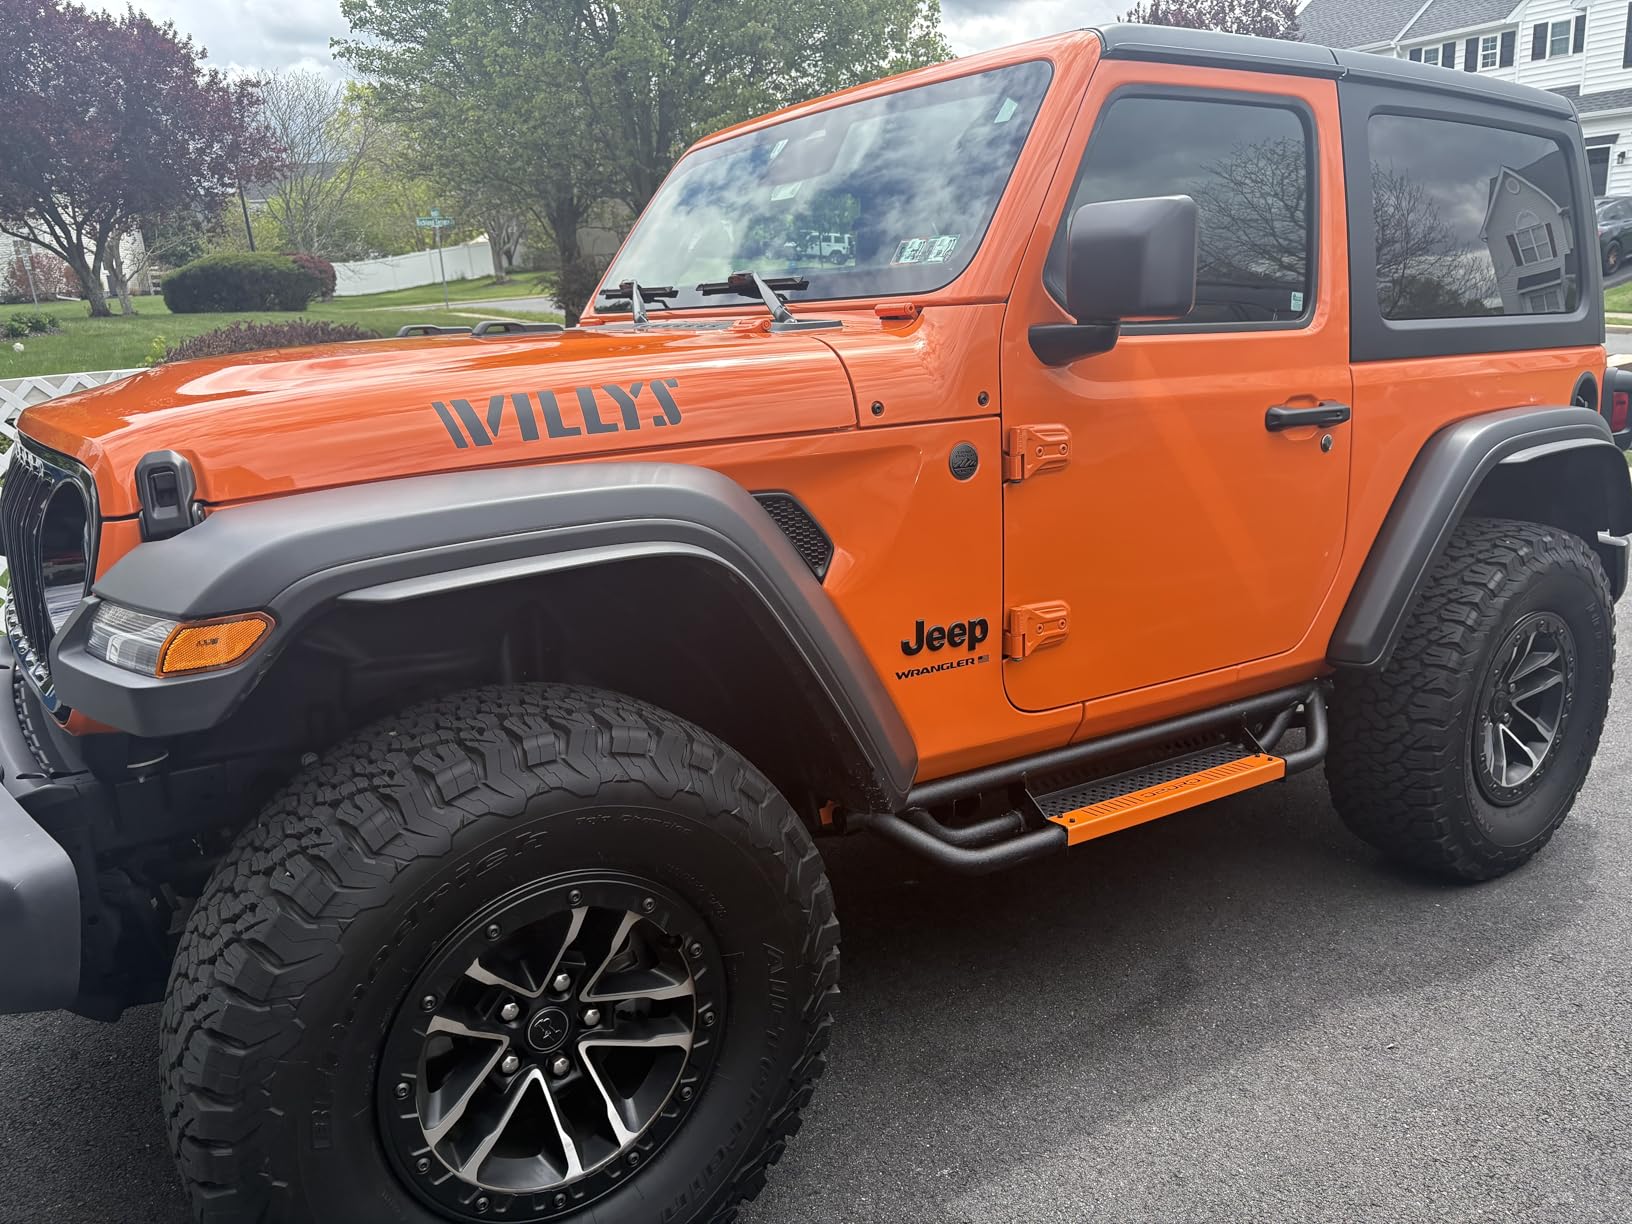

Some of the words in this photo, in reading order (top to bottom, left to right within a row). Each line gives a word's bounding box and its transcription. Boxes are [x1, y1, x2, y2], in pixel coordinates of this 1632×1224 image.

[431, 378, 682, 449] WILLYS
[901, 617, 989, 656] Jeep
[895, 657, 975, 681] WRANGLER
